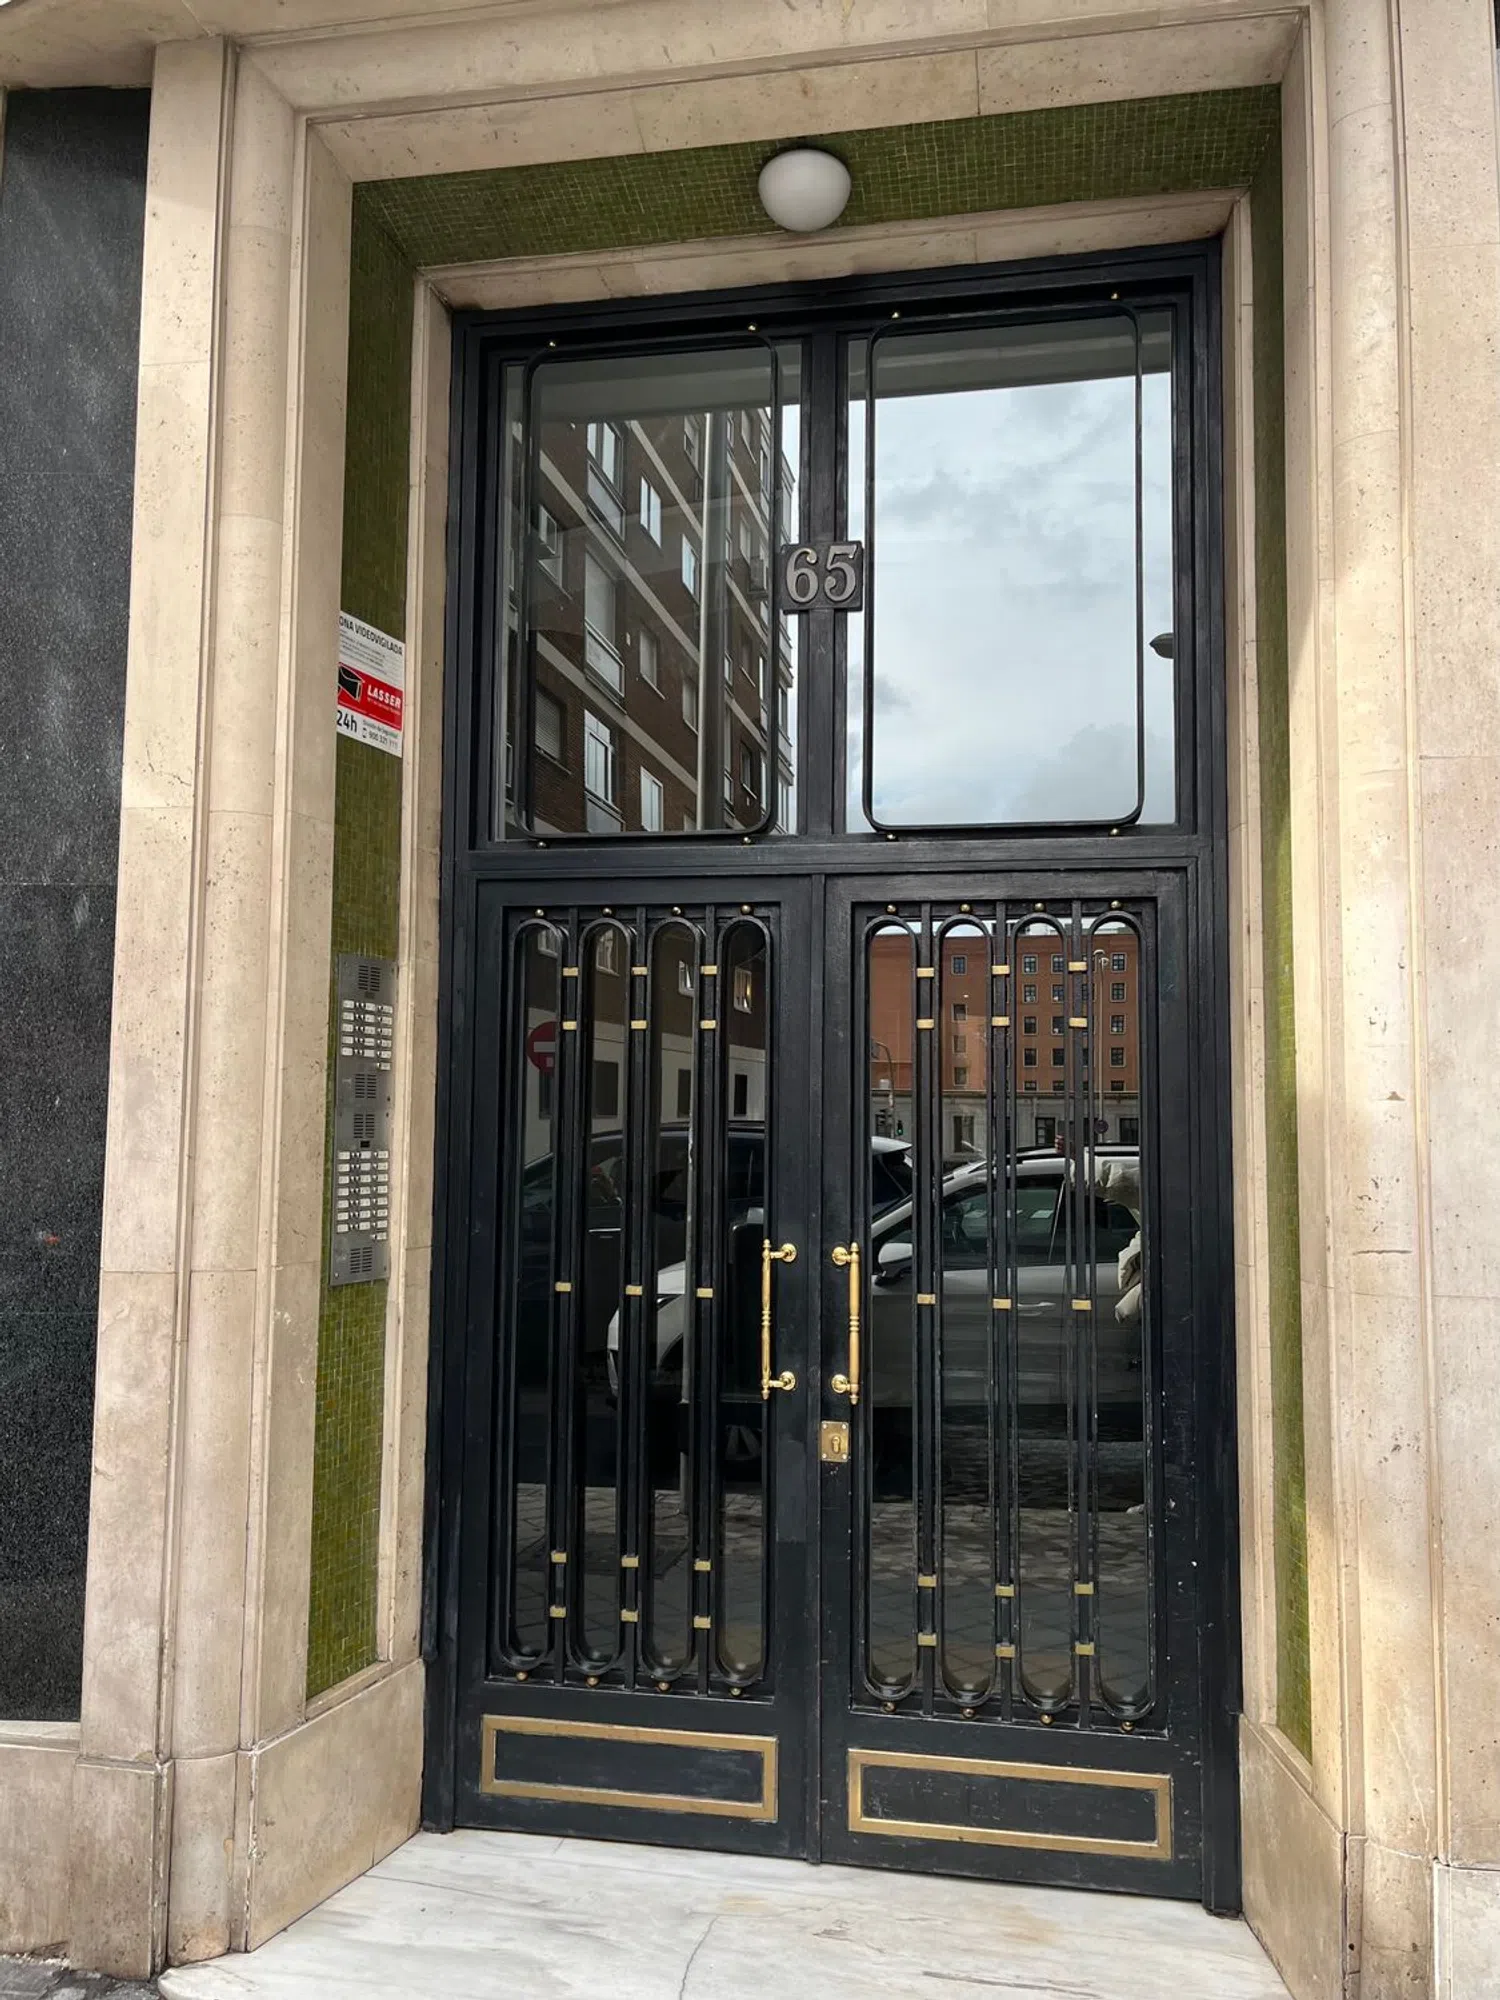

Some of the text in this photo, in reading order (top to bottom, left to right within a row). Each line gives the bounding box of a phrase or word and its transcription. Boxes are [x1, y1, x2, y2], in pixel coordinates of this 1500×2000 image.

[786, 545, 857, 602] 65
[339, 616, 353, 630] ONA
[354, 623, 403, 656] VIDEOVIGILADA
[367, 684, 402, 709] LASSER
[337, 710, 357, 732] 24h
